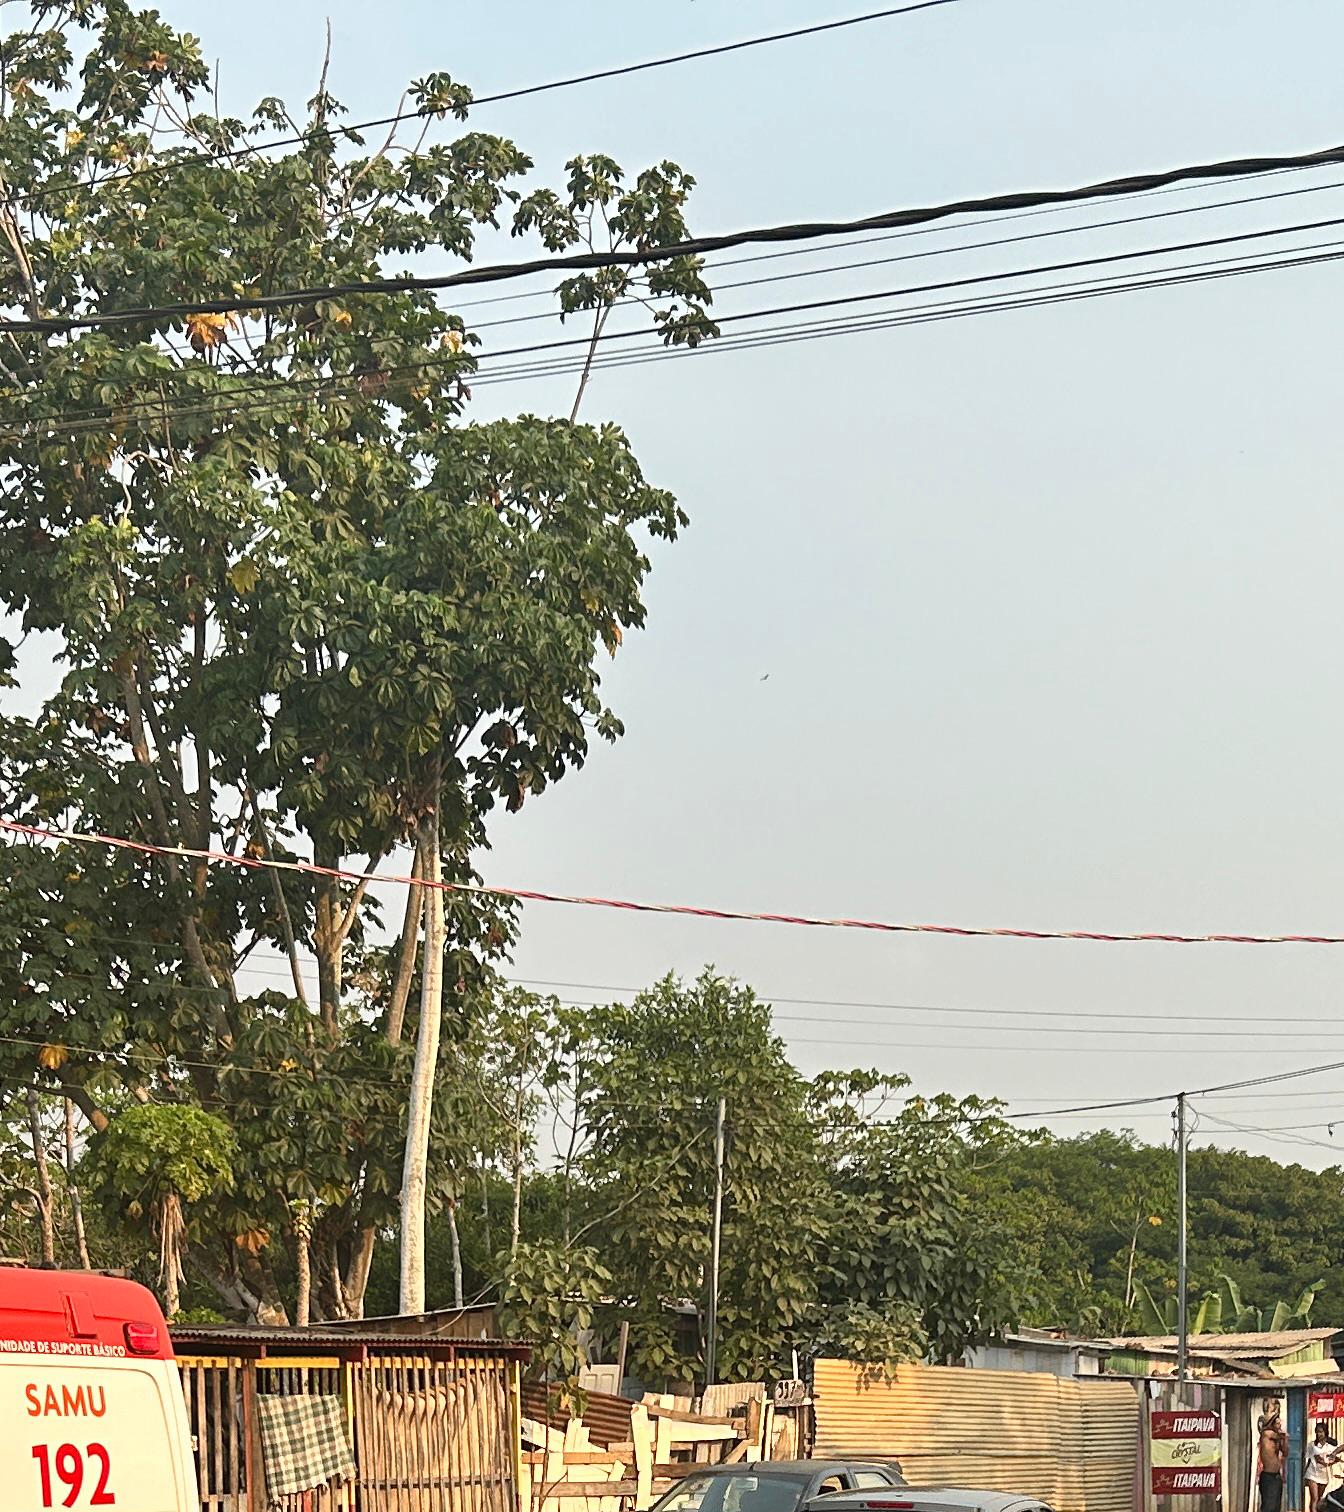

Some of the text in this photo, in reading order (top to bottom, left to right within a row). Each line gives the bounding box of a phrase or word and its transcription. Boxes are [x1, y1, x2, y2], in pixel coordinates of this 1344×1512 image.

[38, 1341, 49, 1352] DE
[51, 1342, 92, 1356] SUPORTE
[93, 1342, 126, 1357] BÁSICO
[25, 1383, 106, 1417] SAMU
[1172, 1417, 1216, 1433] ITAIPAVA
[31, 1442, 116, 1508] 192
[1172, 1472, 1216, 1488] ITAIPAVA
